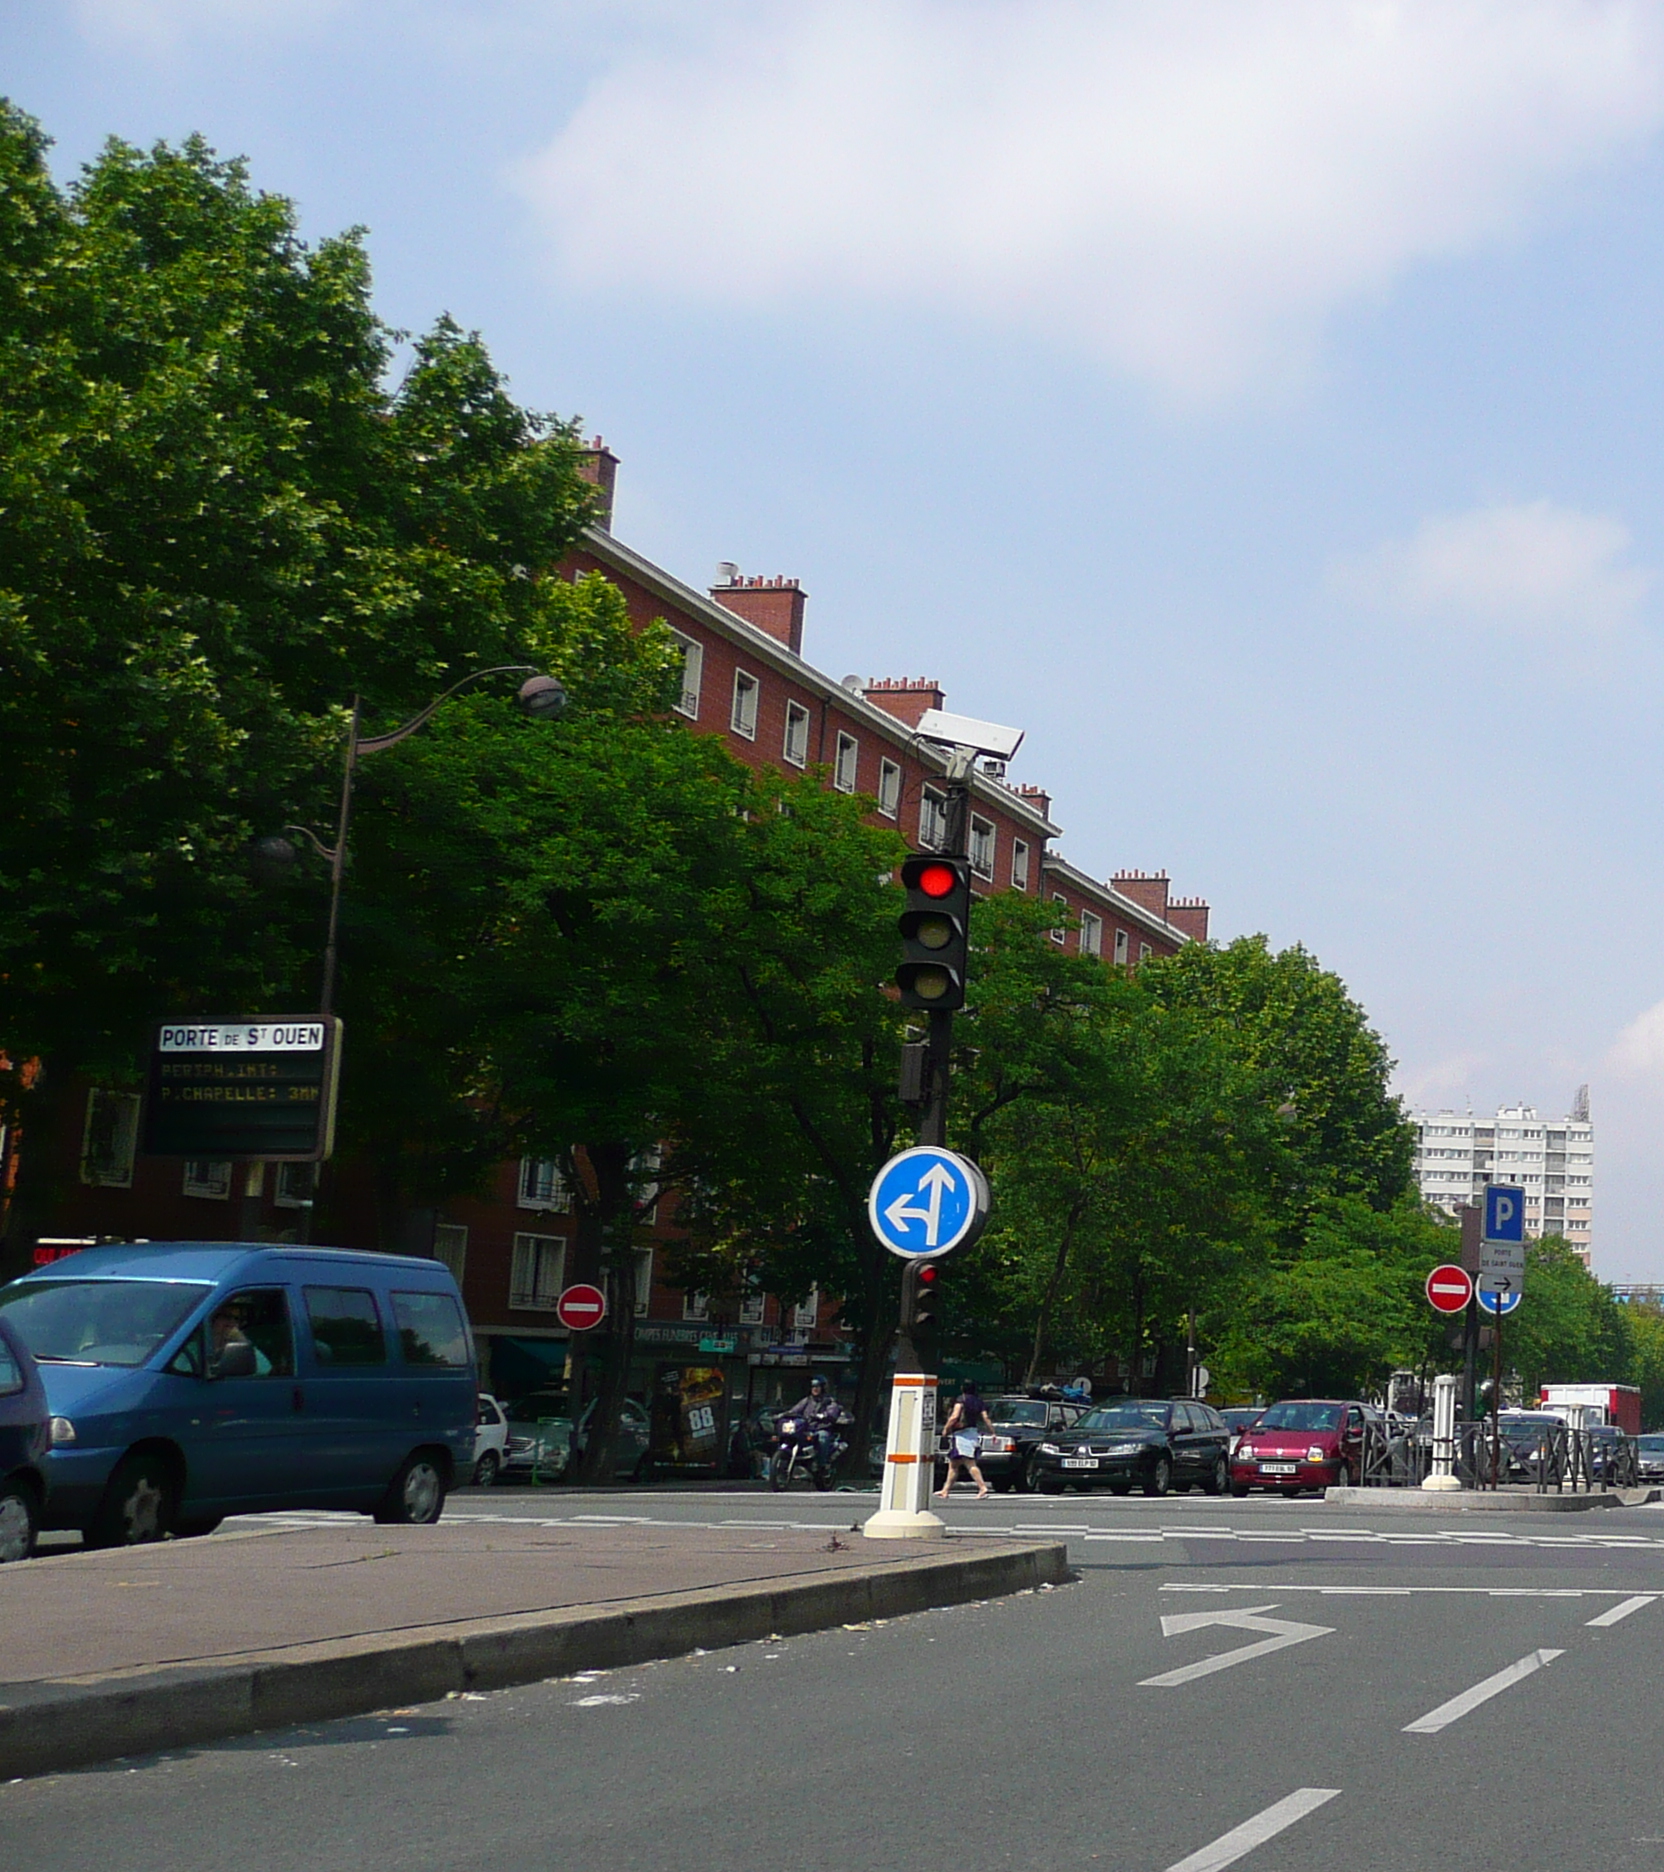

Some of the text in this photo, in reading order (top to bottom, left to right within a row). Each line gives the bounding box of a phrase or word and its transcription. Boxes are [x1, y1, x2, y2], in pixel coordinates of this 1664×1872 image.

[163, 1029, 218, 1046] PORTE
[224, 1034, 240, 1046] DE
[272, 1027, 321, 1045] OUEN
[1495, 1196, 1514, 1231] P
[689, 1406, 714, 1431] 88
